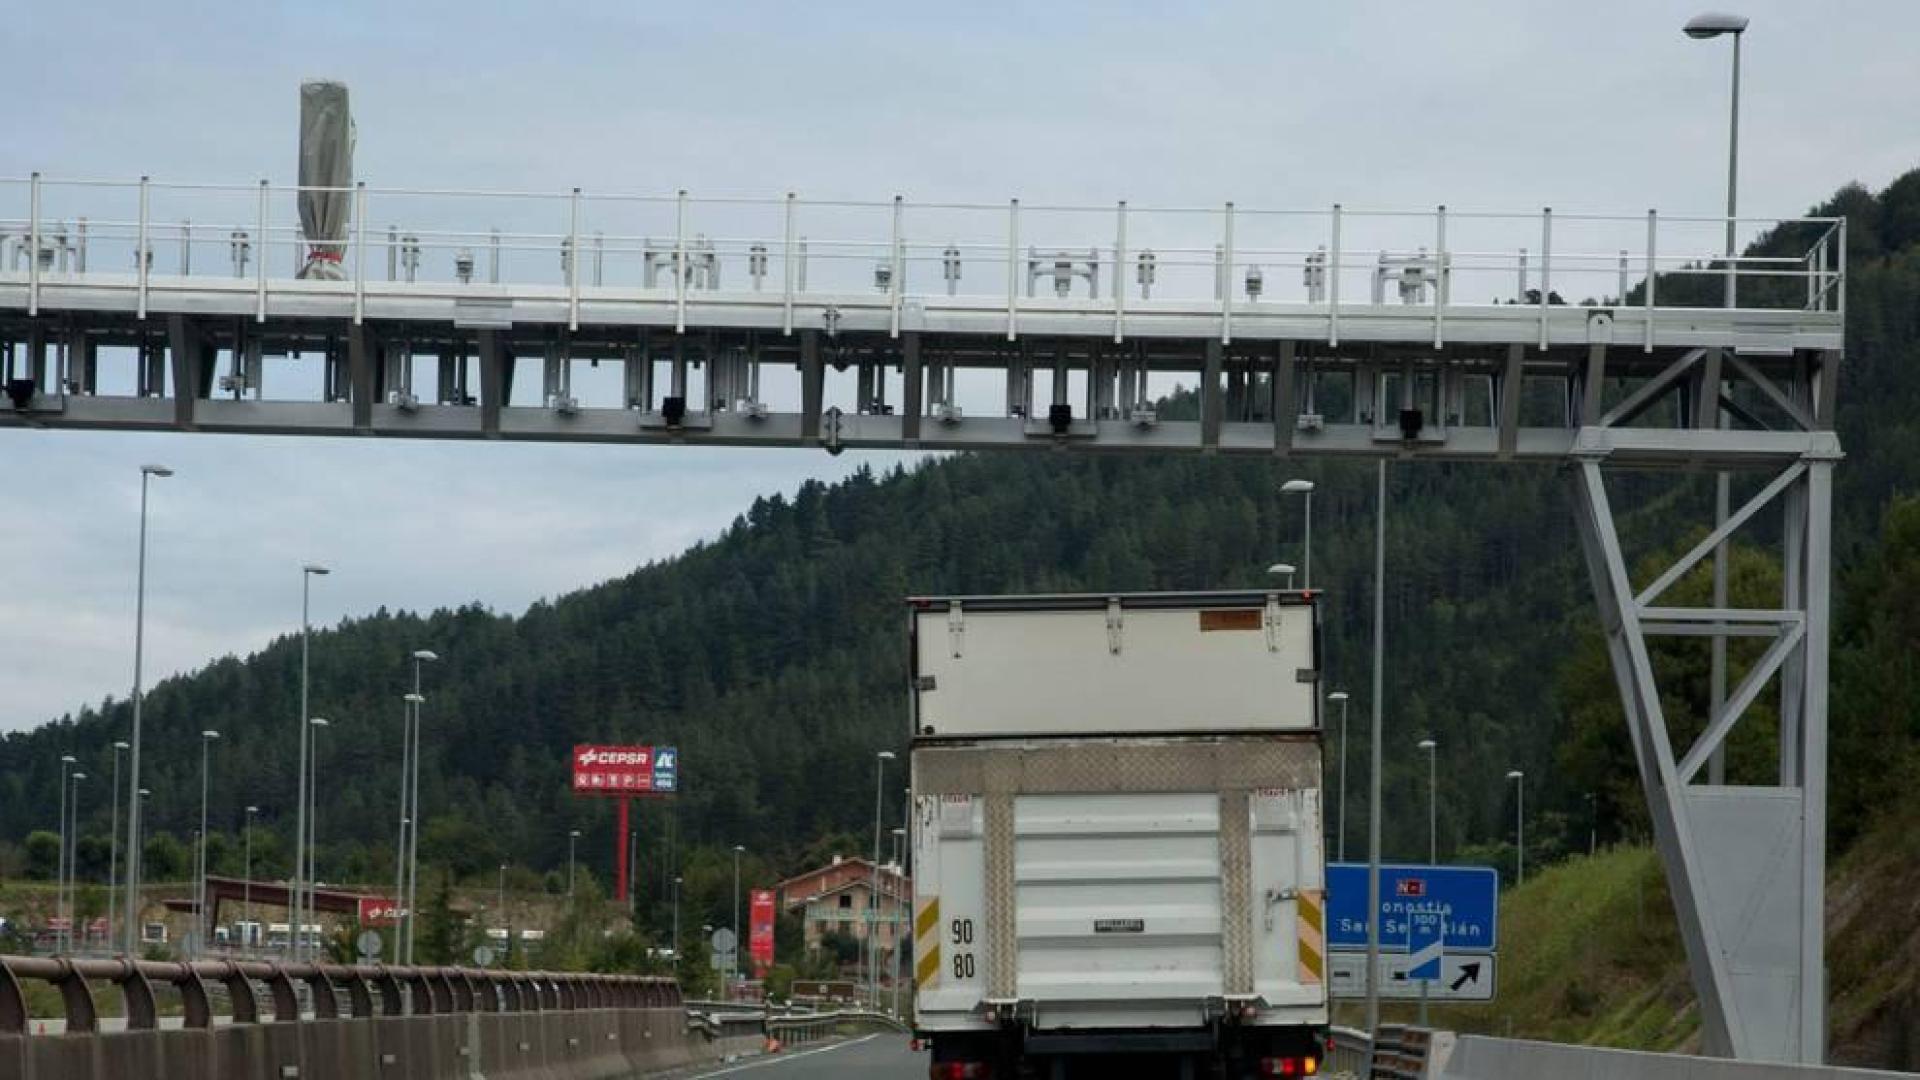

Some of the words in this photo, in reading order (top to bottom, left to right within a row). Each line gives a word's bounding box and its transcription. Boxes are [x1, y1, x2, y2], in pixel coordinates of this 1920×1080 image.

[598, 751, 648, 765] CEPSA
[1372, 900, 1452, 915] onostia
[952, 919, 973, 944] 90
[1386, 919, 1481, 937] Setián
[954, 952, 974, 978] 80
